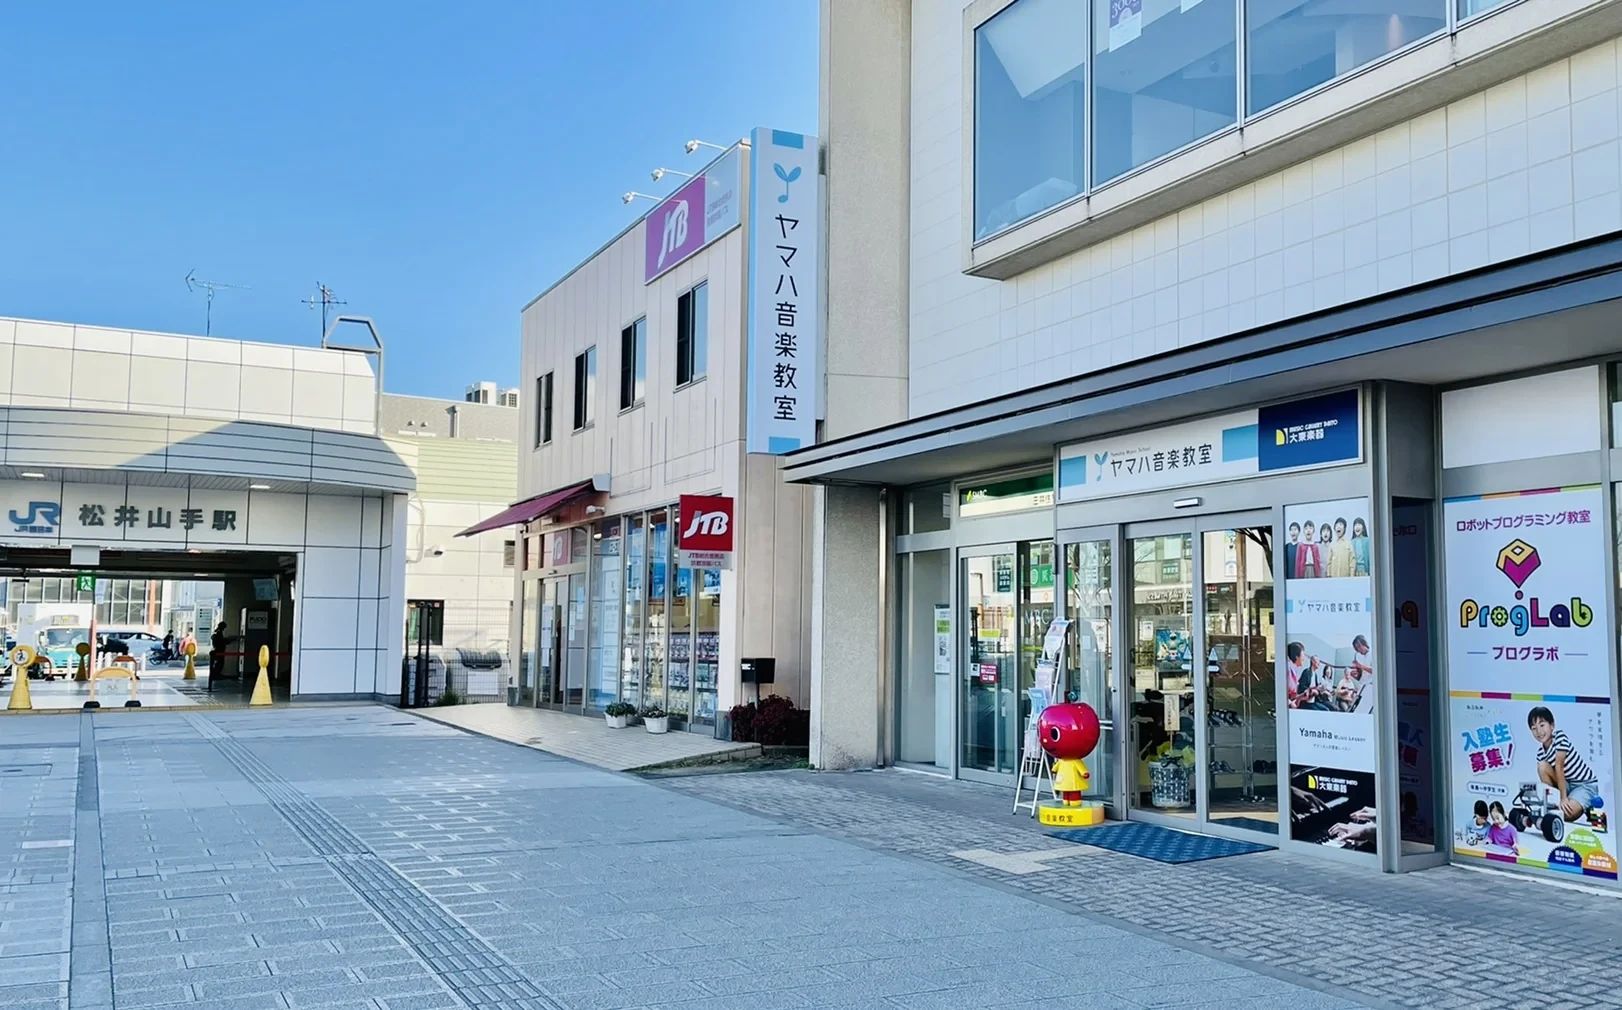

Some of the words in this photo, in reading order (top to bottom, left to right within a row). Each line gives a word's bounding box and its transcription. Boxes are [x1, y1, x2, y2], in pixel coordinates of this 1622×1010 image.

[658, 200, 688, 270] JTB
[773, 213, 799, 421] ヤマハ音楽教室
[1111, 443, 1212, 477] ヤマハ音楽教室
[9, 501, 60, 525] JR
[79, 503, 237, 531] 松井山手駅
[683, 511, 729, 538] JTB
[1456, 510, 1591, 532] ロボットプログラミング教室
[1307, 602, 1361, 613] ヤマハ音楽教室
[1460, 597, 1594, 637] ProgLab
[1299, 727, 1333, 739] Yamaha
[1461, 723, 1512, 752] 入塾生
[1469, 743, 1513, 773] 募集！
